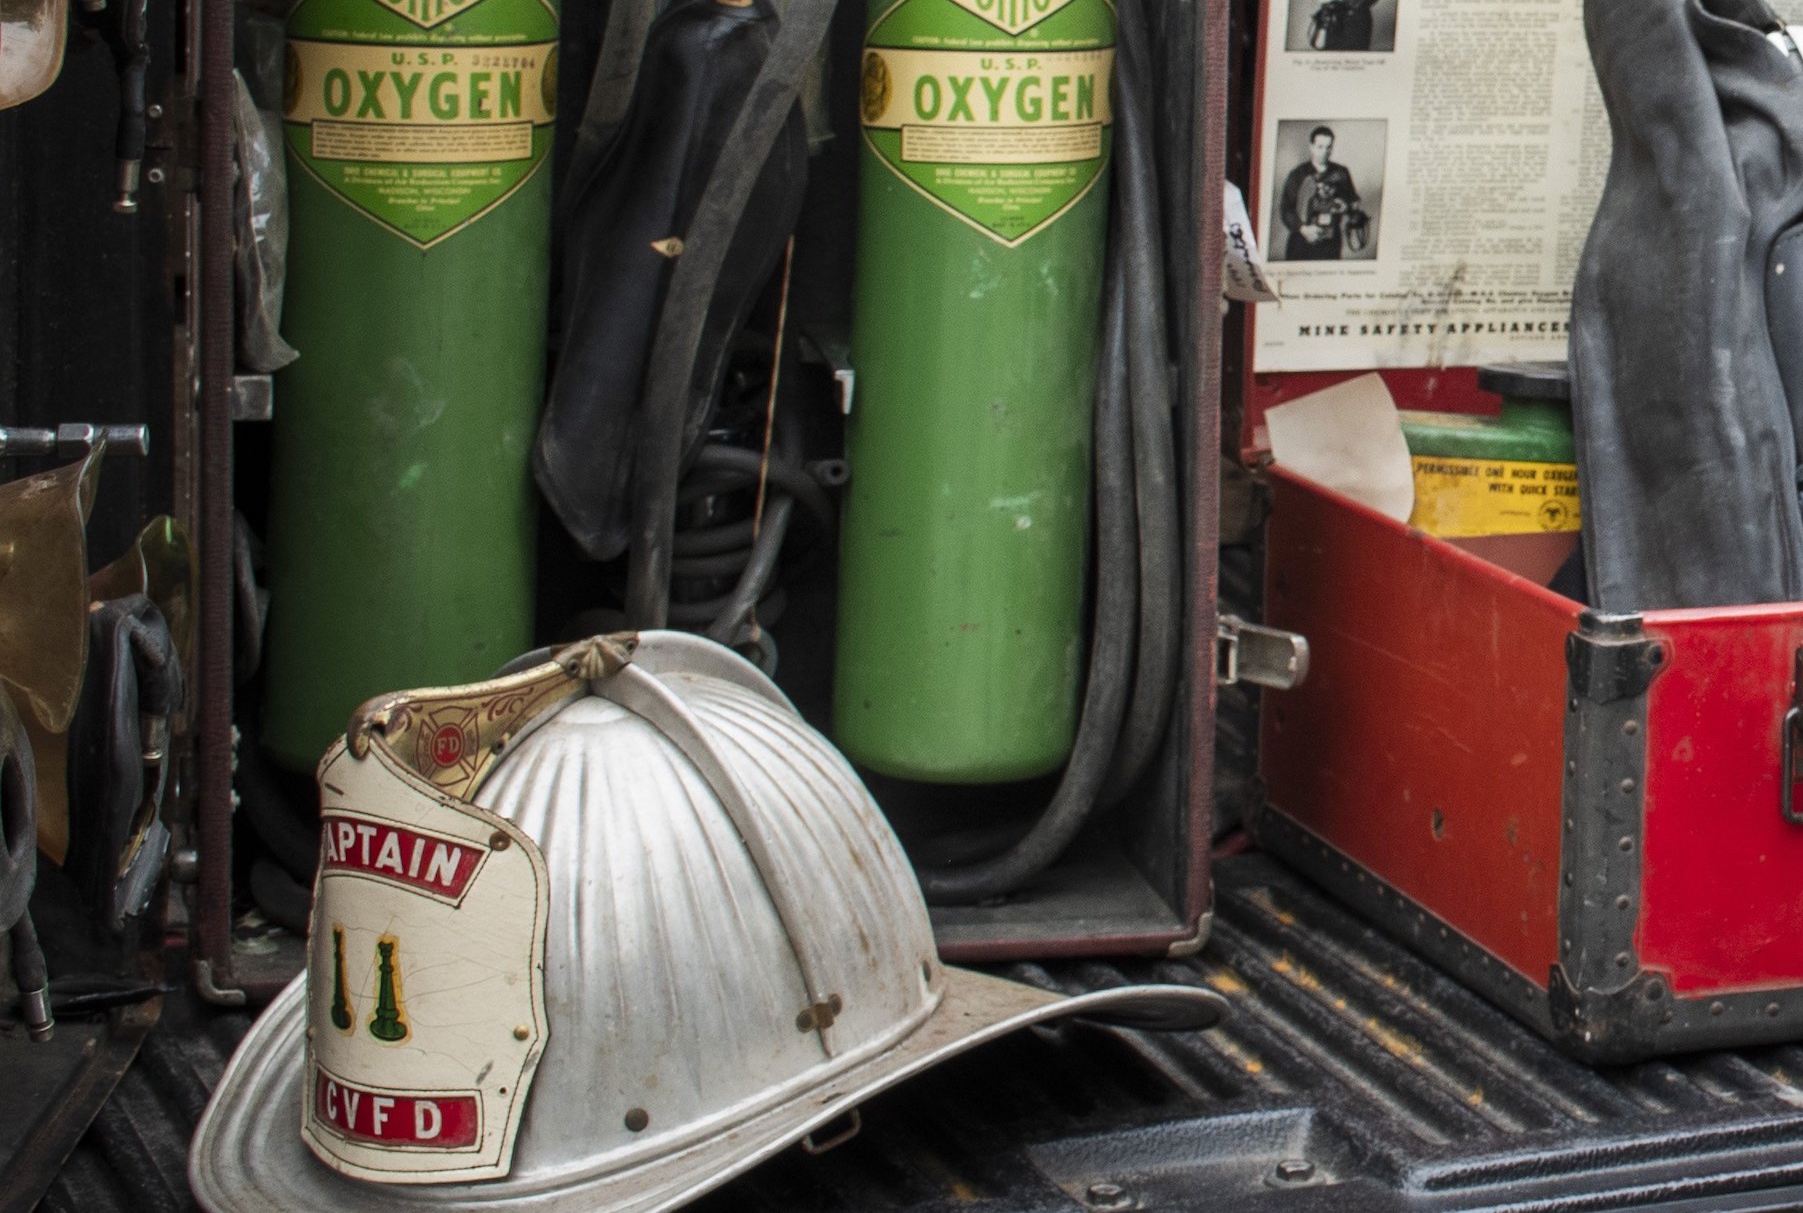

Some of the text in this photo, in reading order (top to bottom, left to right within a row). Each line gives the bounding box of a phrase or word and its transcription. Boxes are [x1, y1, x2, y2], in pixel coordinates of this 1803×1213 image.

[323, 67, 523, 120] OXYGEN
[913, 74, 1095, 123] OXYGEN
[1298, 323, 1350, 337] MINE
[1359, 322, 1438, 337] SAFETY
[1485, 466, 1505, 478] ONE
[1511, 469, 1537, 479] HOUR
[1489, 482, 1580, 496] WITH QUICK STAR
[436, 737, 460, 756] FD
[322, 820, 464, 887] APTAIN
